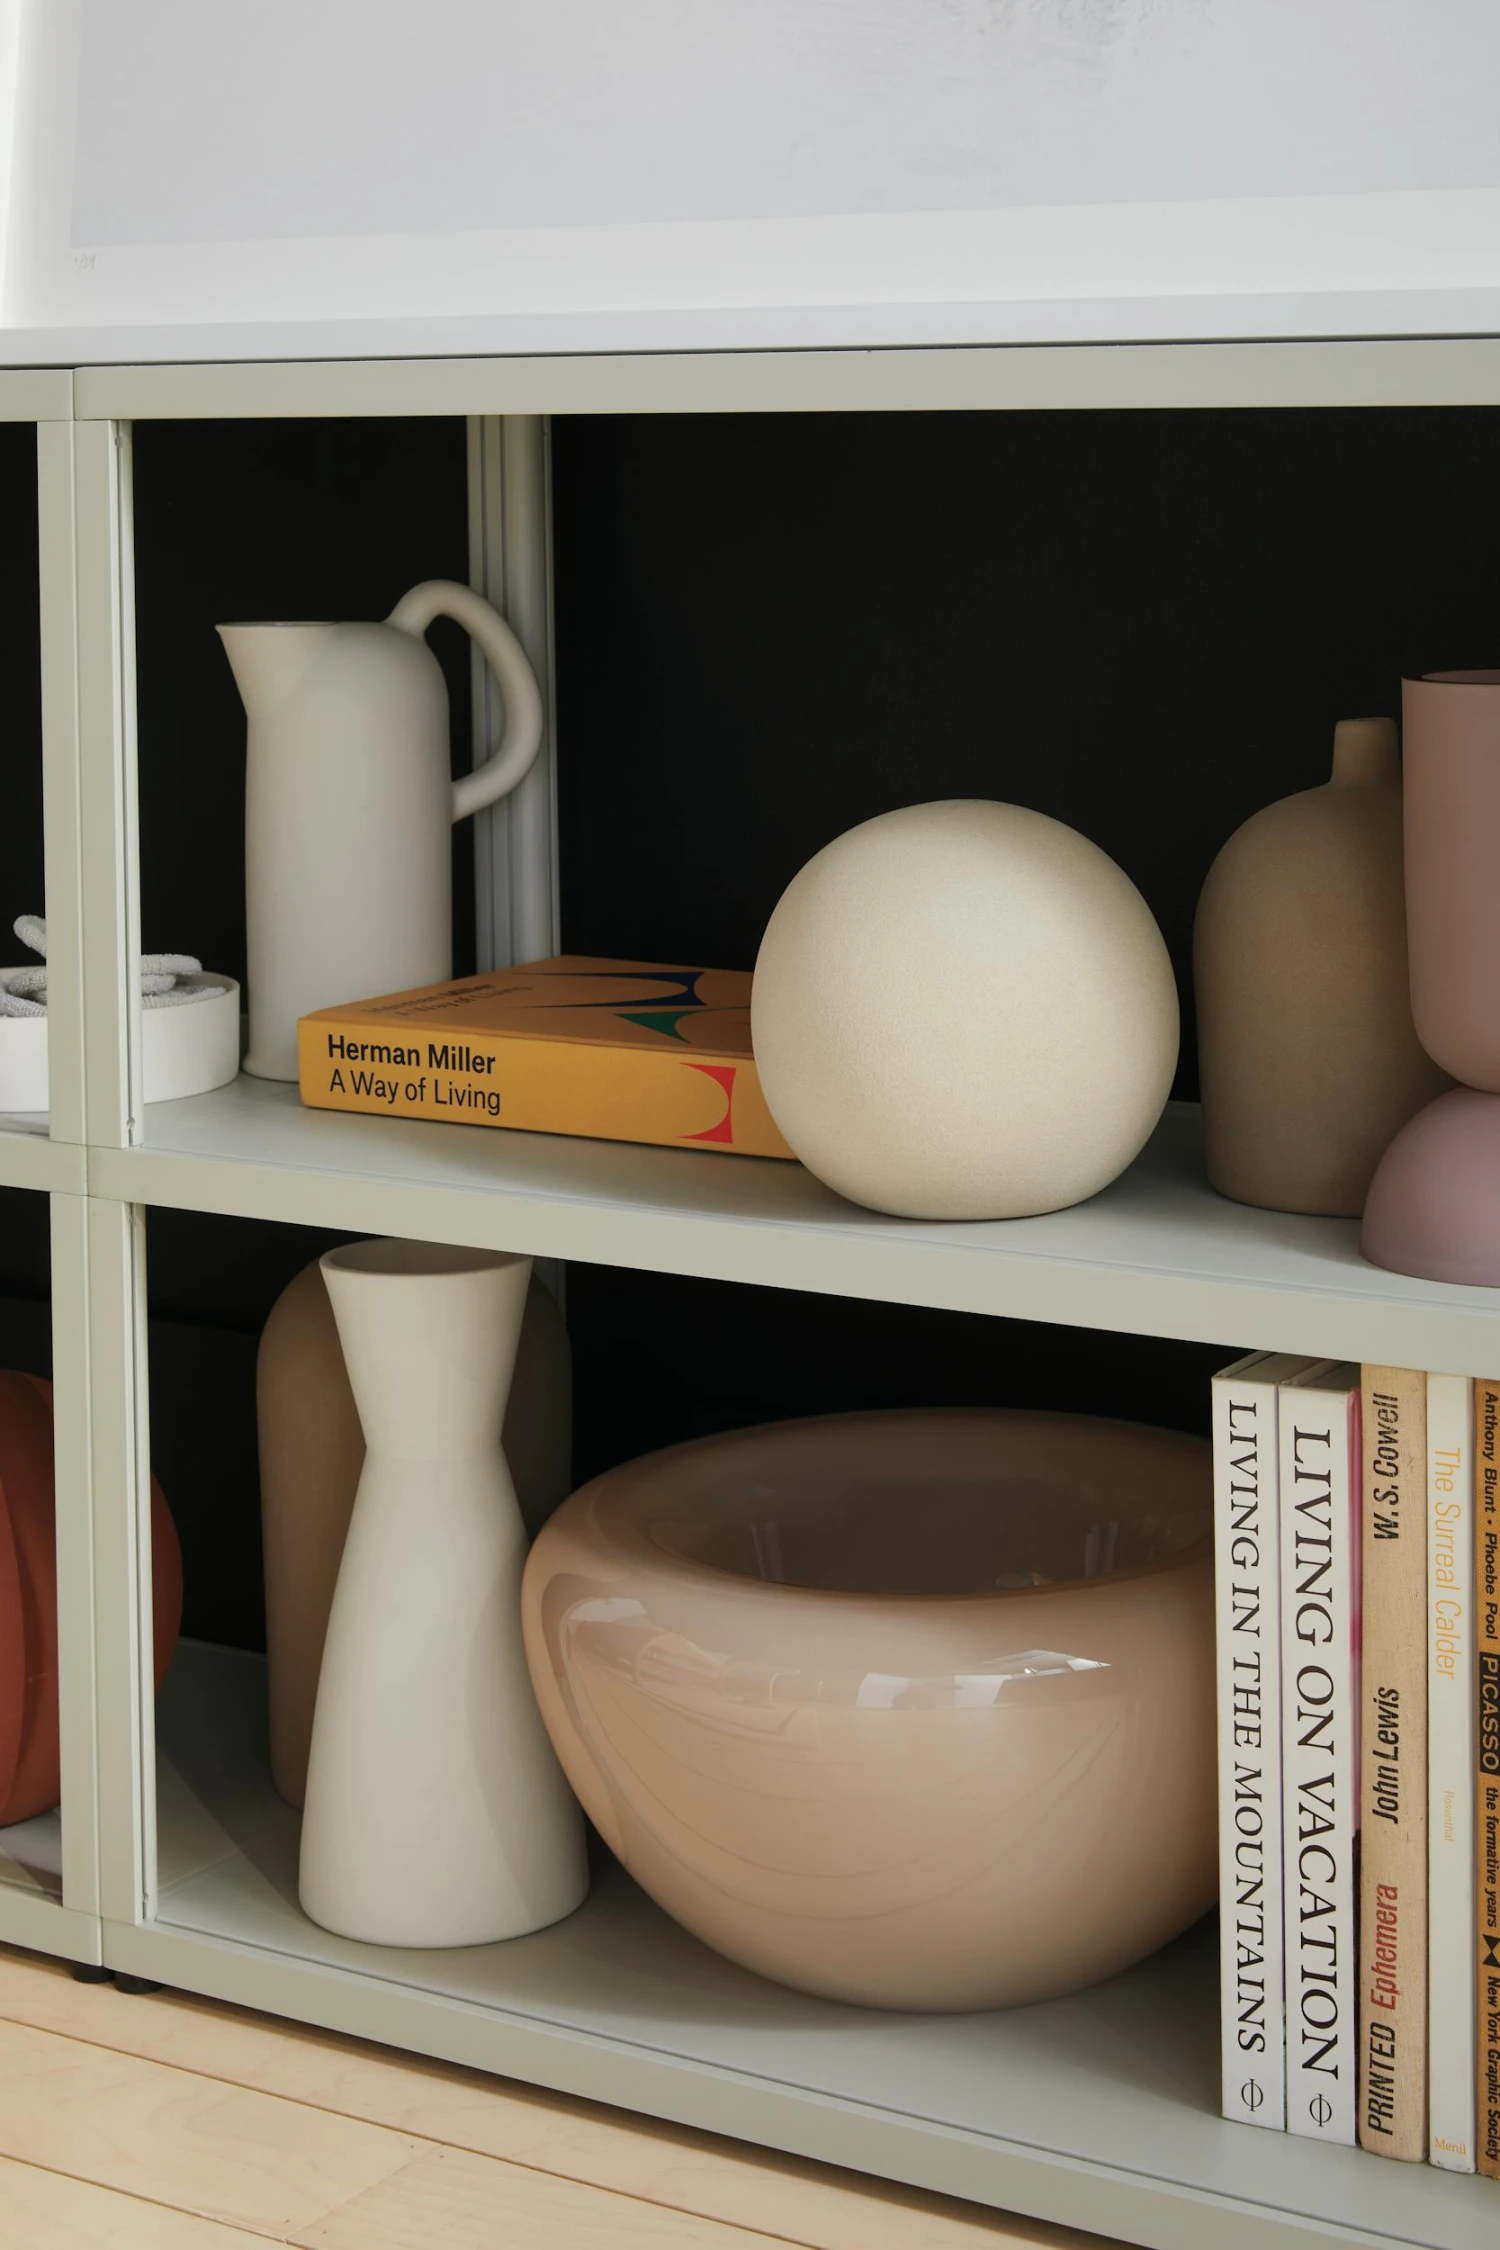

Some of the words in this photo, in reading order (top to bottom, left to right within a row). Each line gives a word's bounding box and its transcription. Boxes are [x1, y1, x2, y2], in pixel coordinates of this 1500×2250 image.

[327, 1033, 421, 1067] Herman
[428, 1043, 496, 1075] Miller
[329, 1068, 346, 1093] A
[350, 1070, 399, 1104] Way
[405, 1077, 427, 1102] of
[434, 1079, 501, 1116] Living
[1373, 1392, 1400, 1478] Cowell
[1482, 1391, 1499, 1462] Anthony
[1229, 1399, 1260, 1570] LIVING
[1373, 1484, 1400, 1506] S.
[1434, 1447, 1462, 1493] The
[1484, 1468, 1498, 1513] Blunt
[1294, 1425, 1334, 1647] LIVING
[1373, 1511, 1400, 1540] W.
[1435, 1501, 1462, 1591] Surreal
[1485, 1531, 1498, 1596] Phoebe
[1232, 1582, 1261, 1638] IN
[1435, 1599, 1462, 1680] Calder
[1485, 1601, 1499, 1640] Pool
[1233, 1651, 1262, 1749] THE
[1296, 1665, 1335, 1756] ON
[1373, 1686, 1400, 1762] Lewis
[1481, 1656, 1499, 1771] PICASSO
[1372, 1764, 1399, 1825] John
[1486, 1786, 1499, 1811] the
[1486, 1815, 1500, 1885] formative
[1234, 1761, 1266, 2054] MOUNTAINS
[1298, 1772, 1339, 2081] VACATION
[1484, 1888, 1498, 1928] years
[1370, 1882, 1403, 2011] Ephemera
[1487, 1975, 1500, 2008] New
[1487, 2012, 1500, 2045] York
[1367, 2021, 1397, 2136] PRINTED
[1484, 2048, 1500, 2105] Graphic
[1433, 2136, 1468, 2155] Menil
[1484, 2108, 1500, 2162] Society
